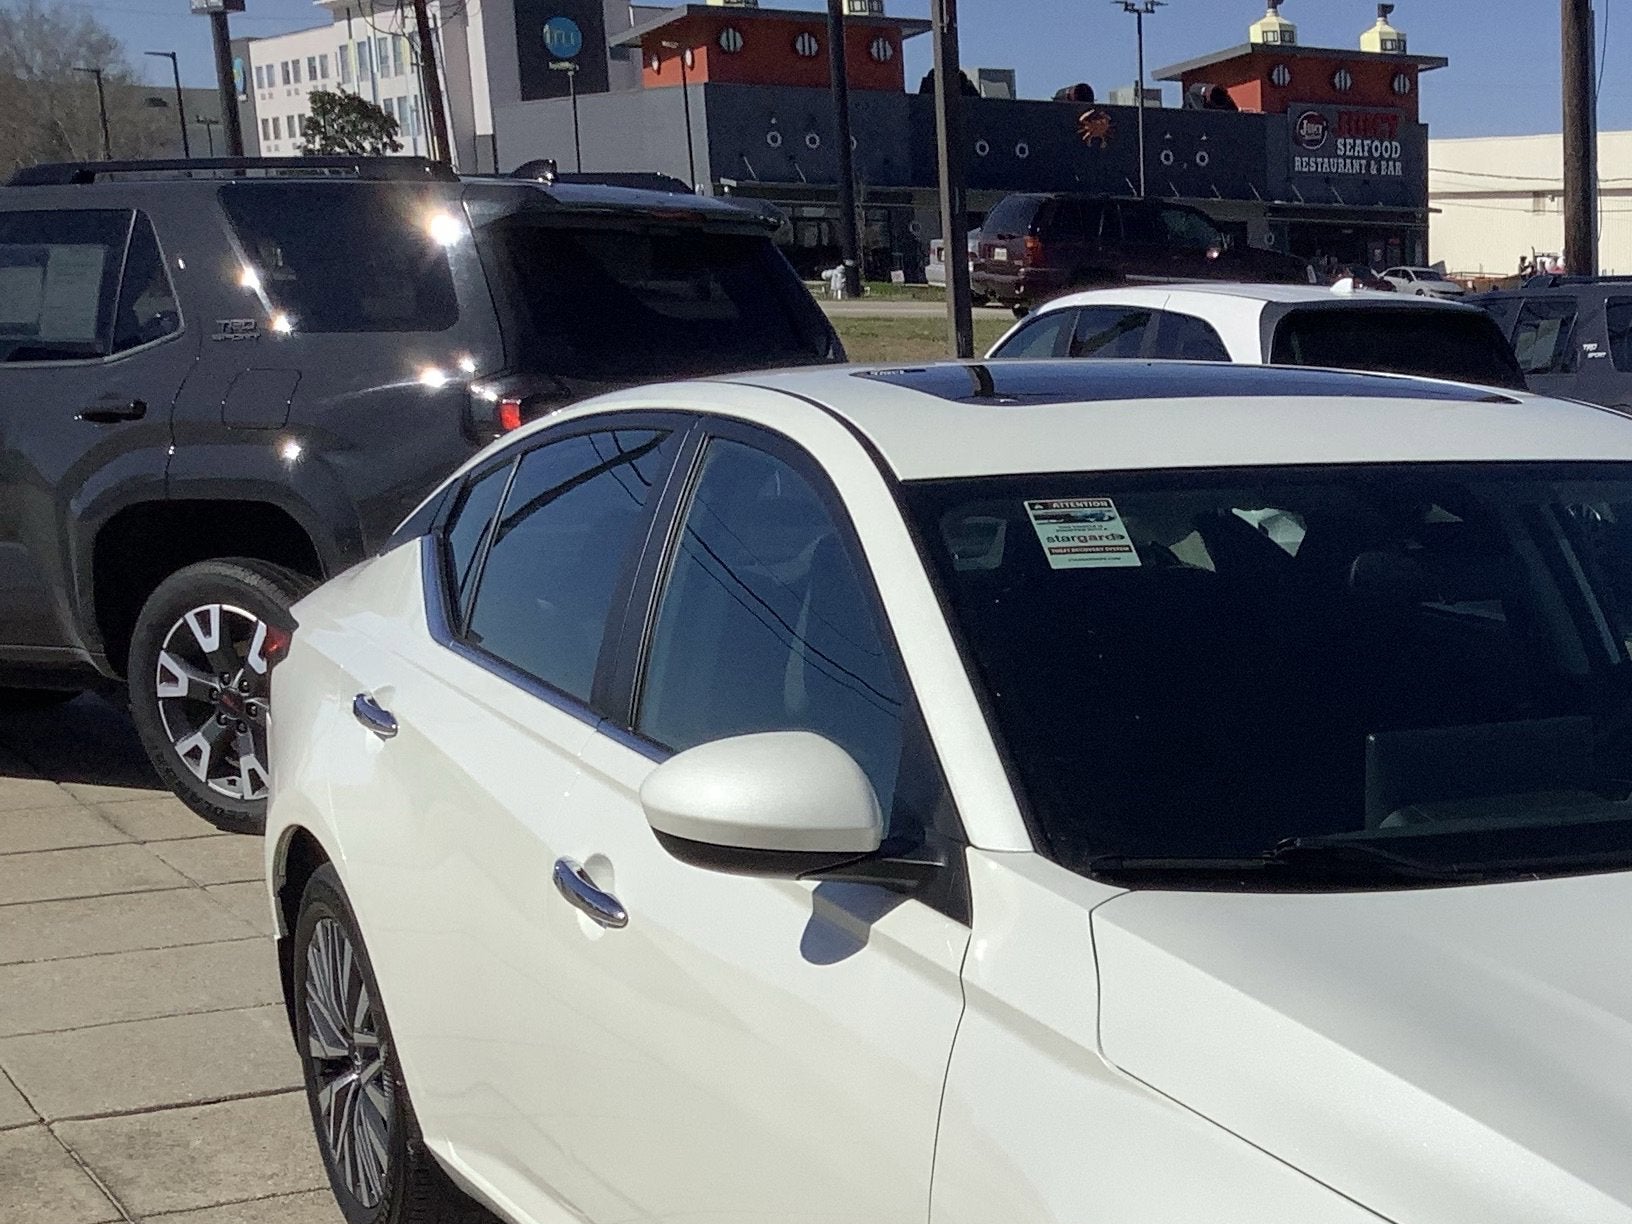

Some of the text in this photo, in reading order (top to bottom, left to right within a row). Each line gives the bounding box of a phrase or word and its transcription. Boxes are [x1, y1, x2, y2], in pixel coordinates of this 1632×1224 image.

[1337, 138, 1401, 159] SEAFOOD
[1294, 156, 1403, 176] RESTAURANT & BAR
[216, 318, 257, 334] TRD
[1052, 500, 1108, 509] ATTENTION
